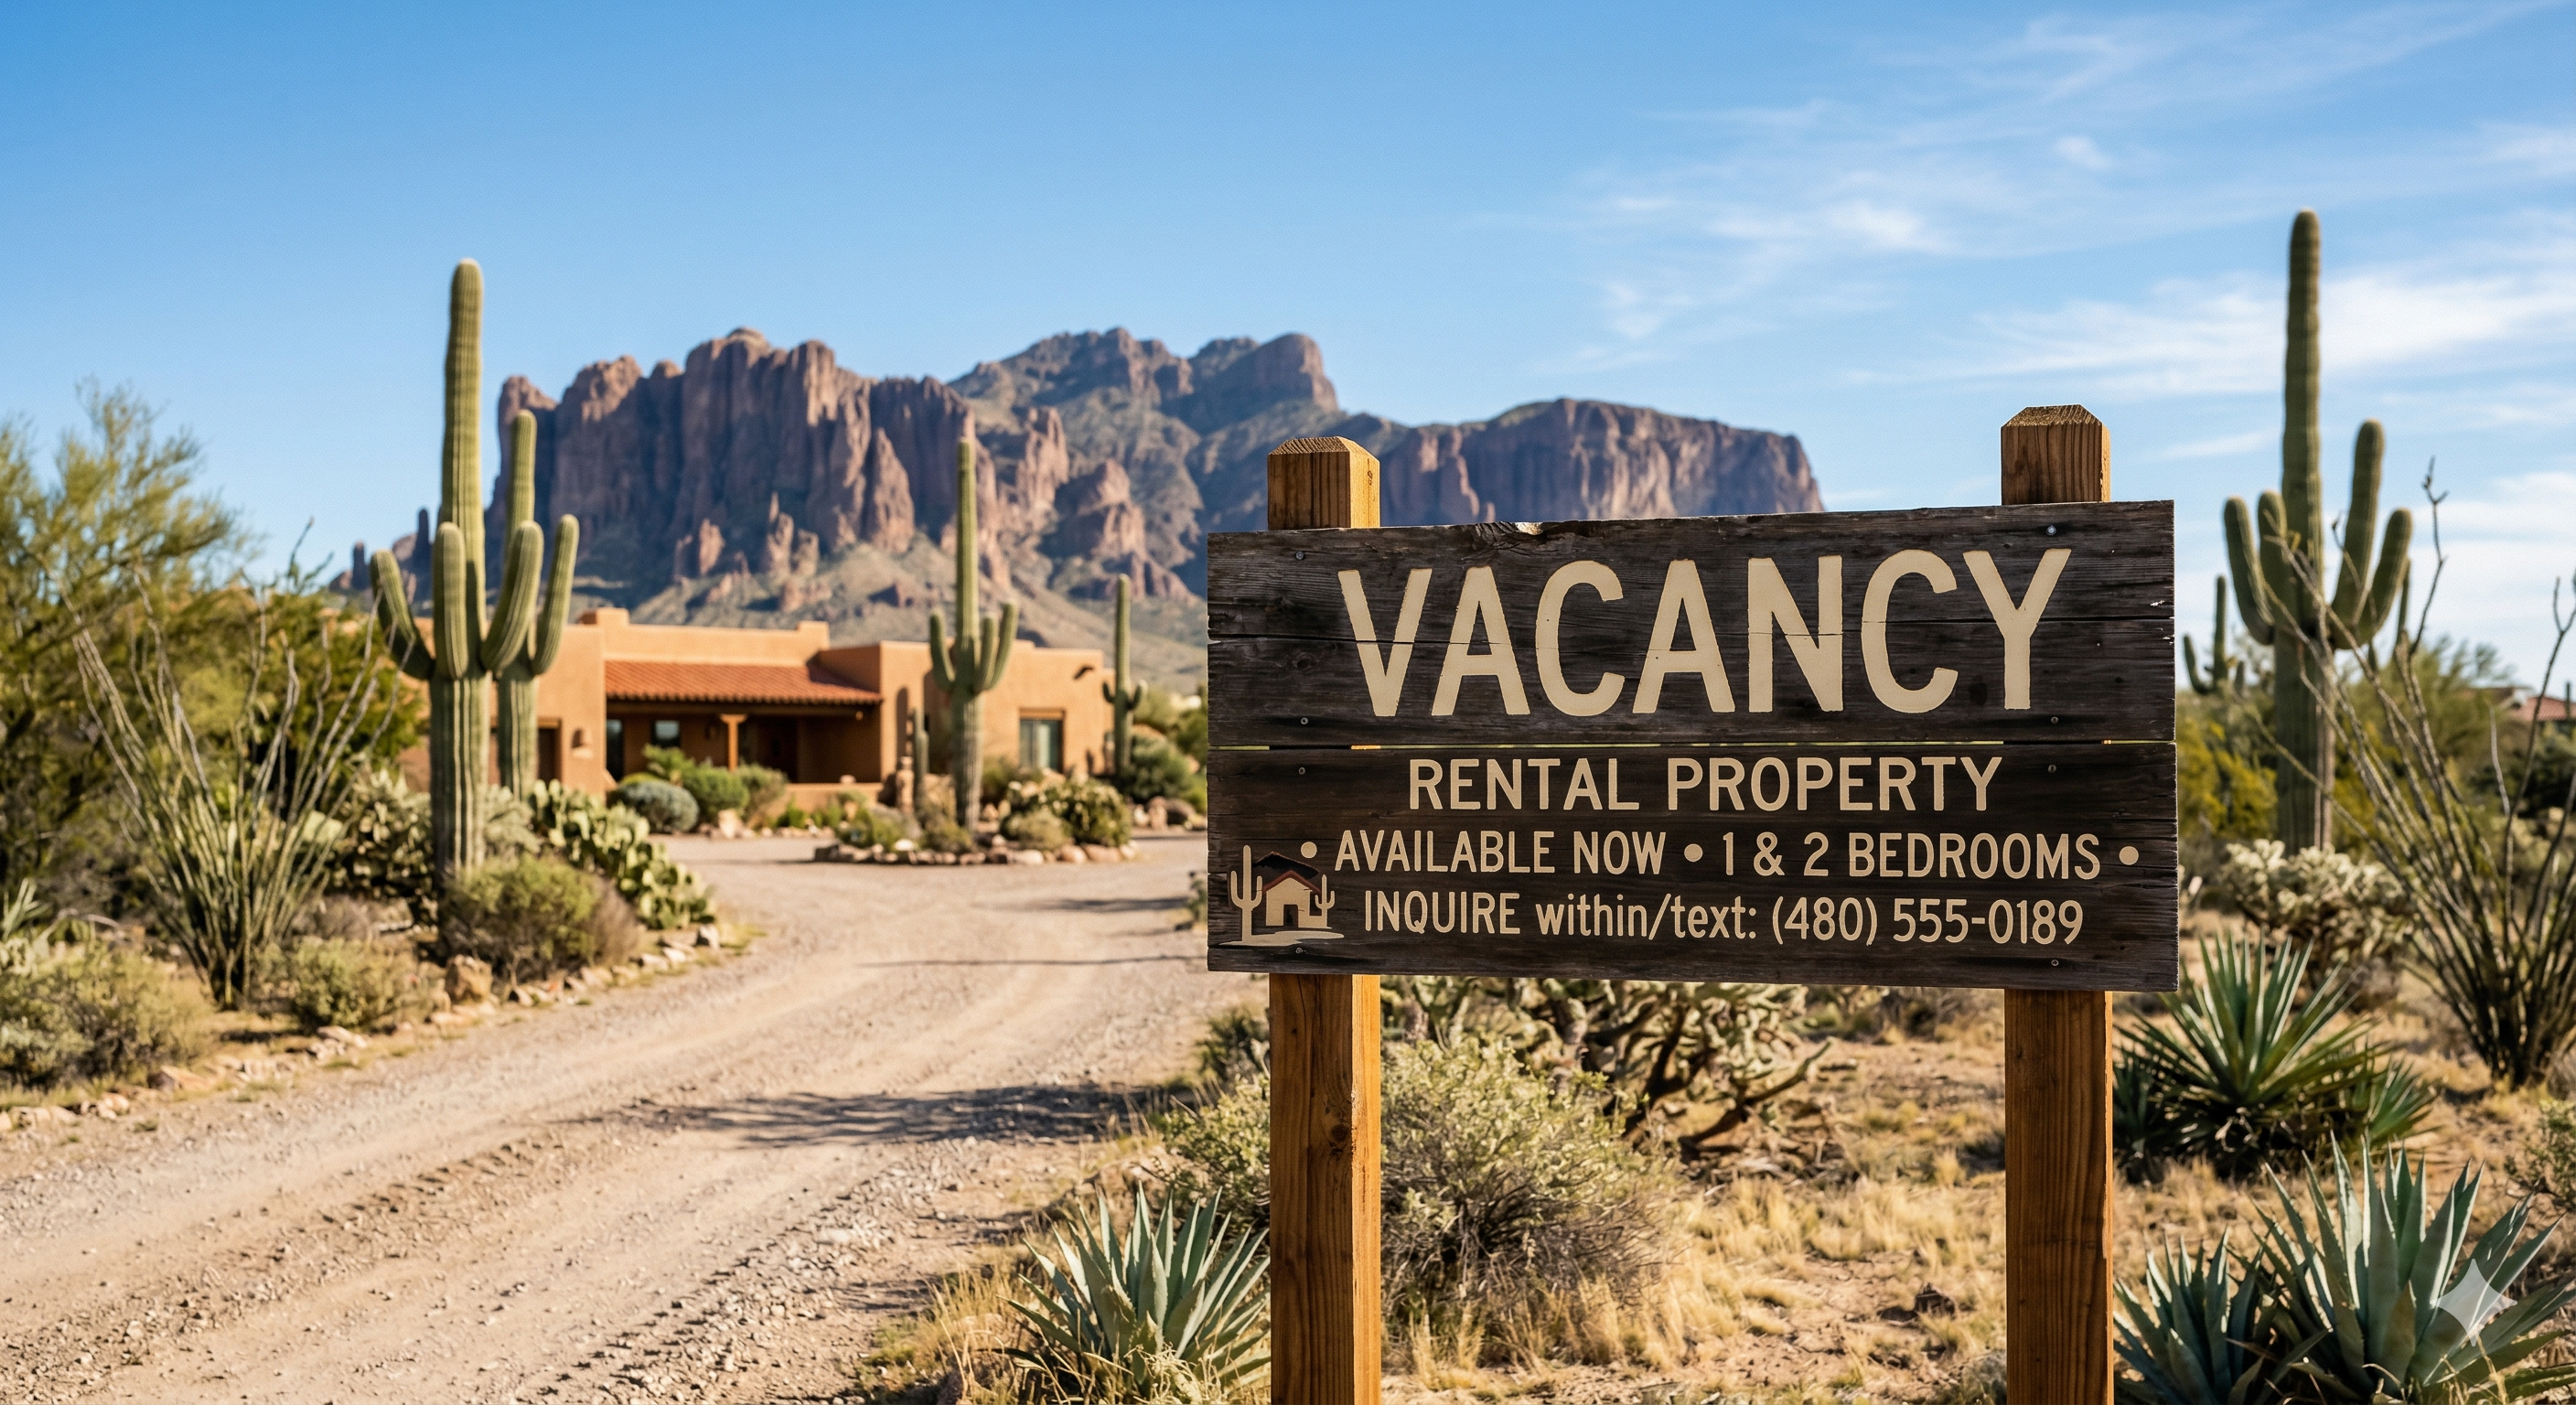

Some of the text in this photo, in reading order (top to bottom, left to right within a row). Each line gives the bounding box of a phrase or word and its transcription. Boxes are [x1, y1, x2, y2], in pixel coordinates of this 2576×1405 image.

[1337, 548, 2072, 717] VACANCY
[1409, 756, 2003, 811] RENTAL PROPERTY
[1334, 829, 2100, 880] AVAILABLE NOW 1 & 2 BEDROOMS
[1365, 890, 2084, 947] INQUIRE within/text: (480) 555-0189
